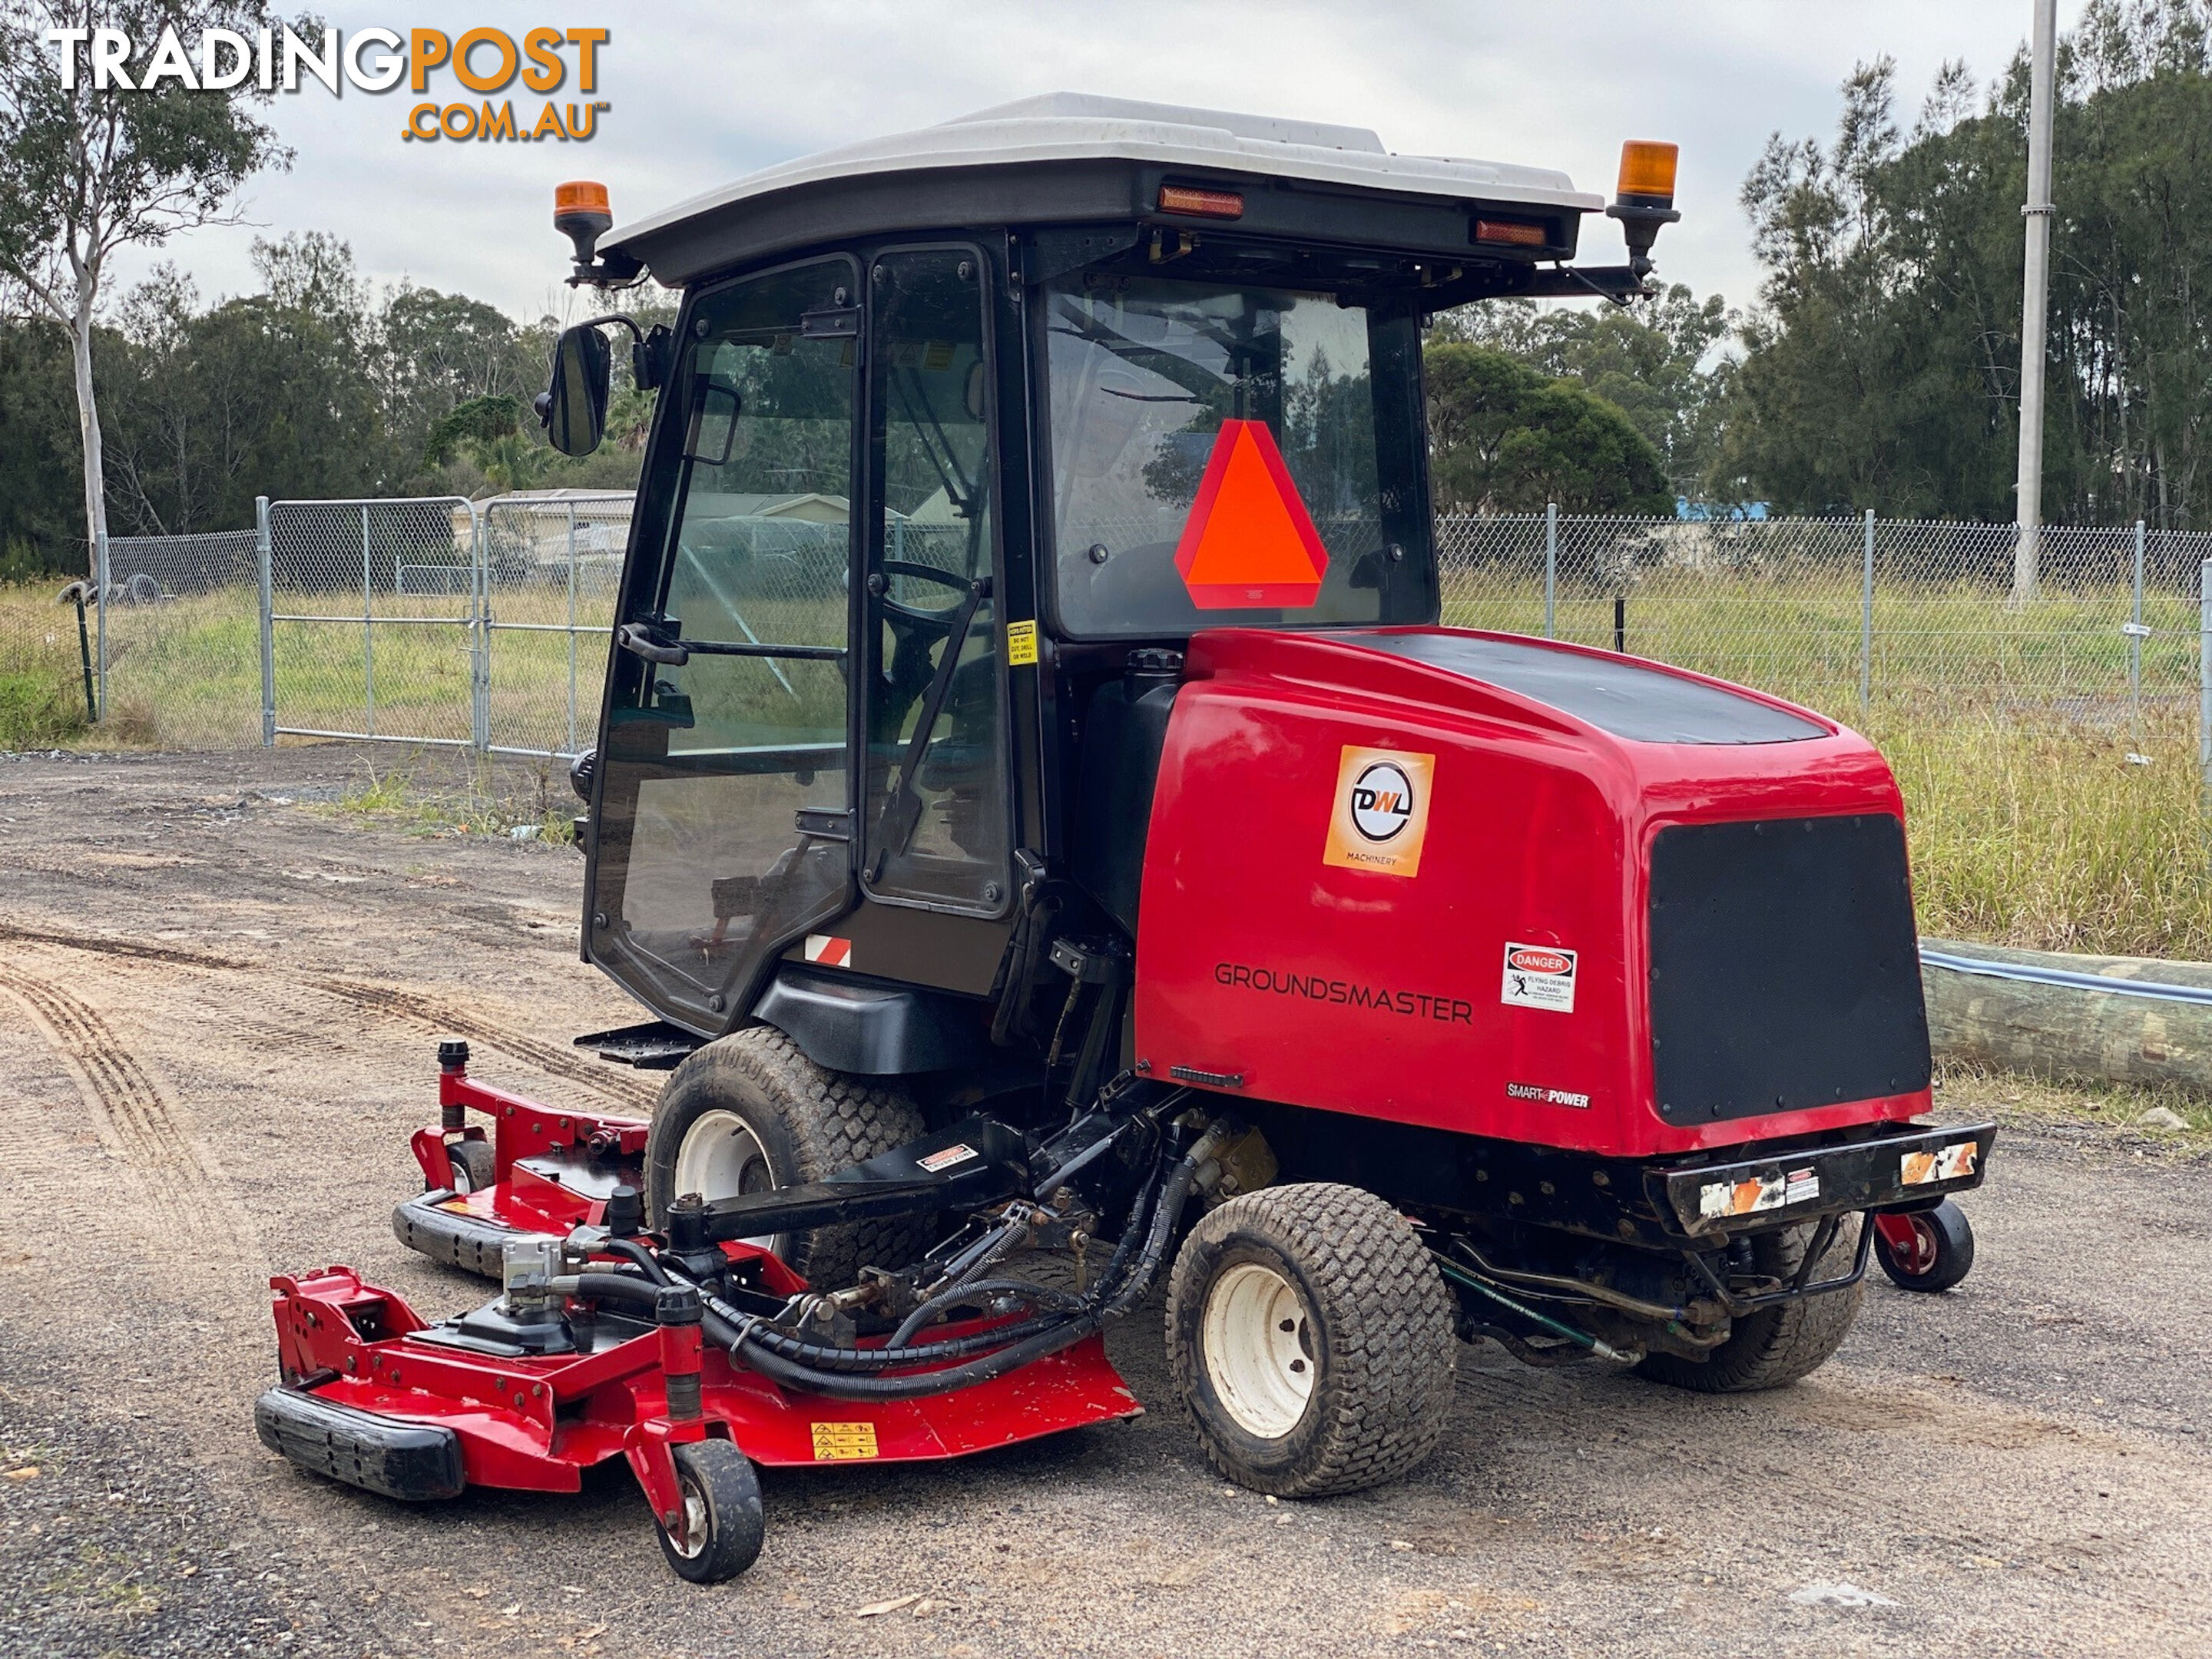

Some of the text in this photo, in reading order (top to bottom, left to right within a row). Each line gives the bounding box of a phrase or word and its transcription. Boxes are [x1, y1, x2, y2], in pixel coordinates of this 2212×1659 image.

[1353, 788, 1411, 816] DWL
[1346, 852, 1397, 866] MACHINERY
[1516, 954, 1564, 970] DANGER
[1528, 975, 1571, 988] FLYING DEBRIS
[1214, 962, 1473, 1026] GROUNDSMASTER
[1507, 1083, 1589, 1108] SMART POWER
